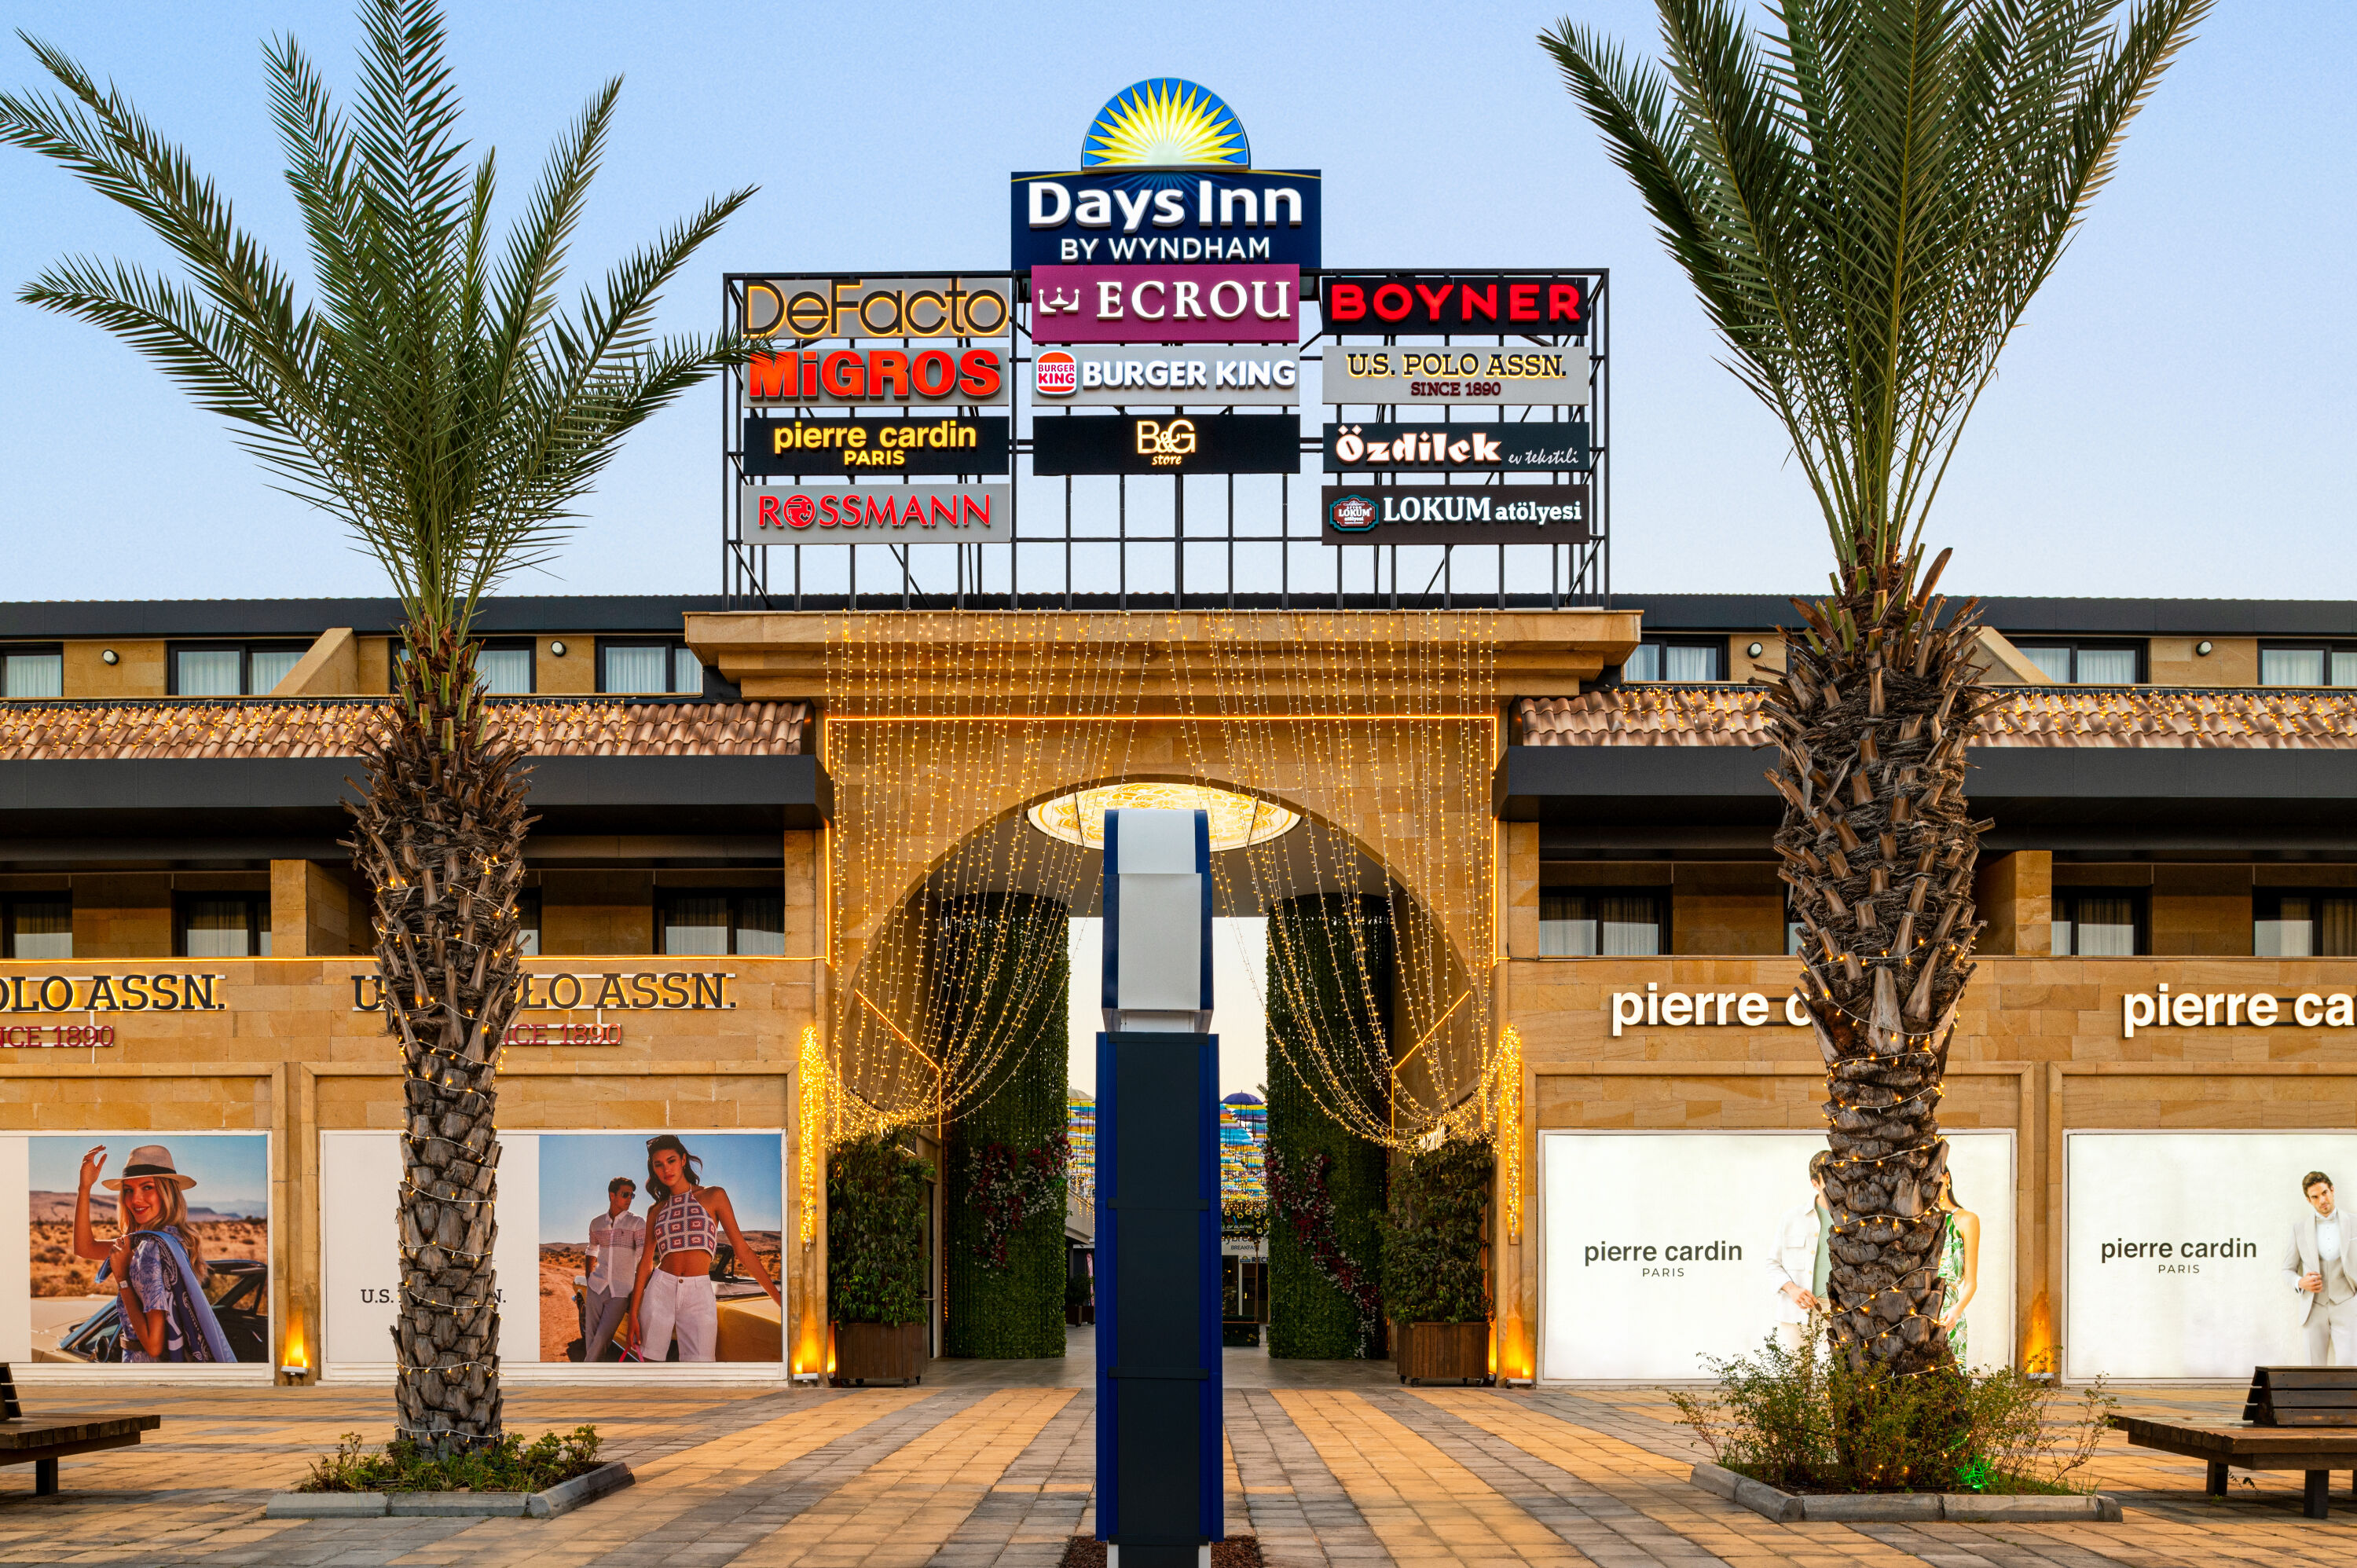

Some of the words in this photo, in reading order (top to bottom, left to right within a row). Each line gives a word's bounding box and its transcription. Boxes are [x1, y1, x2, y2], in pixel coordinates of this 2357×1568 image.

[1028, 181, 1185, 233] Days
[1199, 180, 1302, 226] Inn
[1061, 238, 1099, 262] BY
[1109, 236, 1270, 262] WYNDHAM
[742, 280, 1007, 335] DeFacto
[1097, 280, 1291, 321] ECROU
[1332, 284, 1581, 321] BOYNER
[1038, 373, 1075, 384] KING
[1083, 360, 1207, 388] BURGER
[1216, 360, 1296, 388] KING
[1347, 354, 1395, 376] U.S.
[1403, 353, 1479, 377] POLO
[1485, 354, 1567, 378] ASSN.
[1410, 382, 1461, 396] SINCE
[1465, 382, 1501, 396] 1890
[774, 421, 867, 453] pierre
[880, 420, 977, 448] cardin
[1137, 419, 1196, 454] B&G
[1336, 424, 1502, 462] Özdilek
[1508, 453, 1523, 464] ev
[1525, 447, 1578, 464] tekstili
[844, 450, 905, 466] PARIS
[1151, 454, 1182, 465] store
[758, 494, 991, 528] ROSSMANN
[1383, 496, 1491, 522] LOKUM
[1495, 500, 1582, 525] atölyesi
[84, 974, 225, 1011] ASSN.
[594, 973, 736, 1009] ASSN.
[1613, 982, 1769, 1037] pierre
[2124, 983, 2278, 1038] pierre
[52, 1025, 114, 1047] 1890
[559, 1024, 621, 1045] 1890
[1585, 1240, 1657, 1266] pierre
[1665, 1240, 1743, 1261] cardin
[2102, 1237, 2173, 1263] pierre
[2180, 1237, 2257, 1258] cardin
[1643, 1268, 1684, 1277] PARIS
[2158, 1264, 2201, 1273] PARIS
[361, 1288, 394, 1303] U.S.
